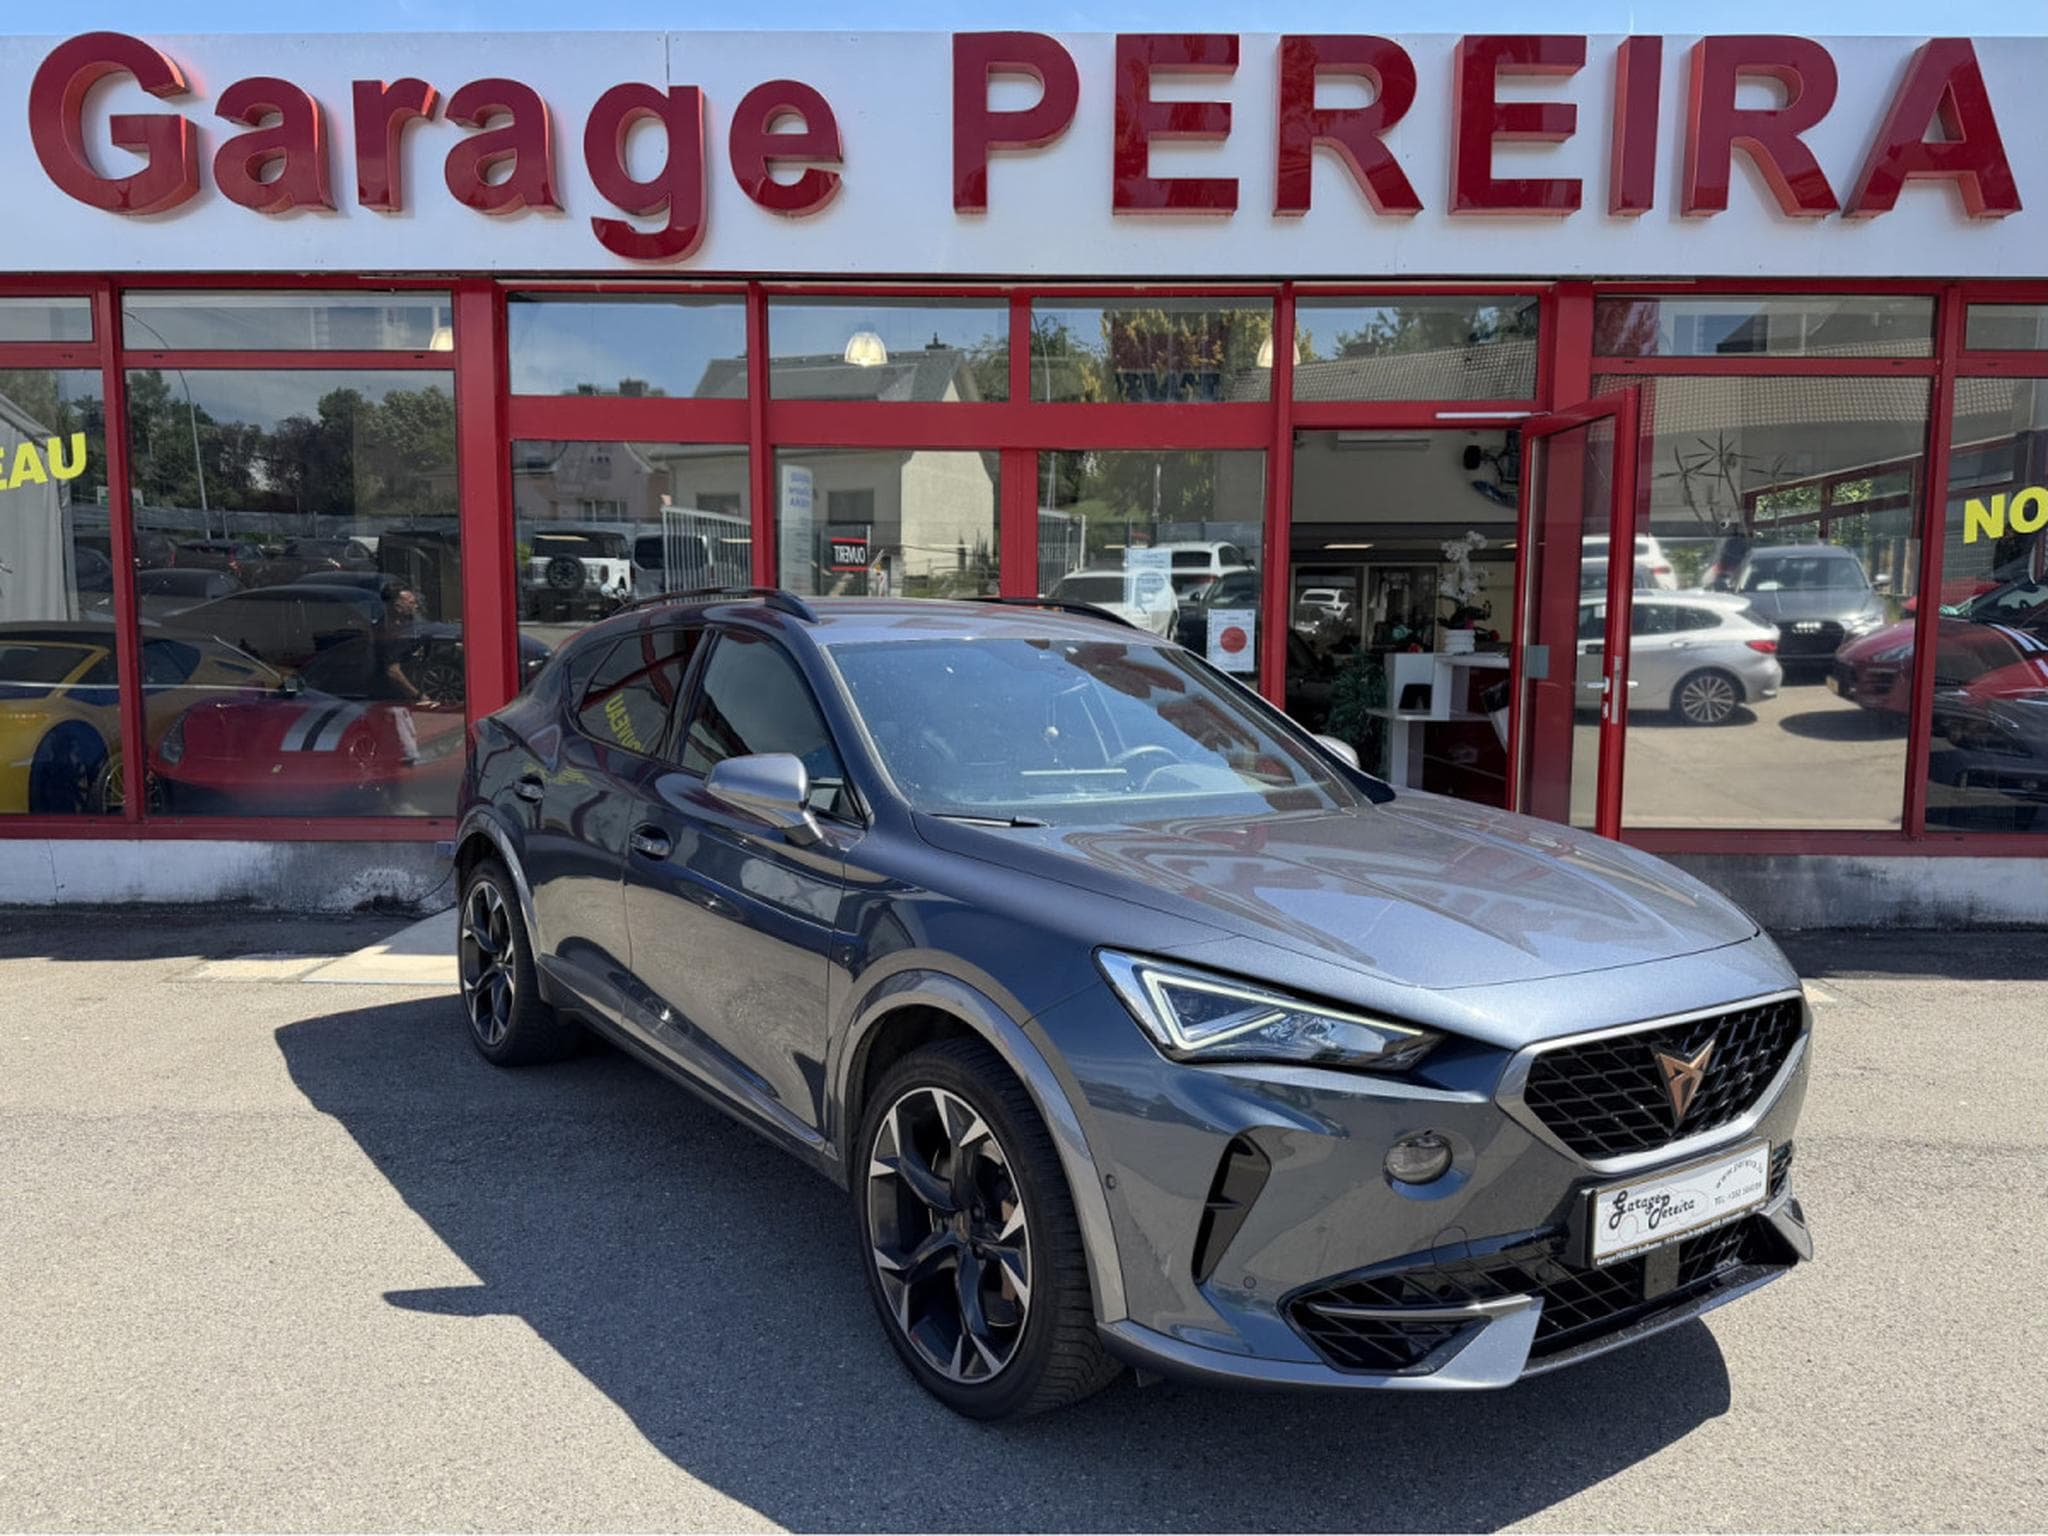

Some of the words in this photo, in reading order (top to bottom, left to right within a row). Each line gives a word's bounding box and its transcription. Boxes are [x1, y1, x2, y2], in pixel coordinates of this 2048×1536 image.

[28, 31, 843, 261] Garage
[953, 31, 2022, 219] PEREIRA
[0, 432, 86, 490] AU
[1963, 486, 2048, 544] NO
[1609, 1190, 1662, 1230] Garage
[1648, 1194, 1695, 1230] Pereira
